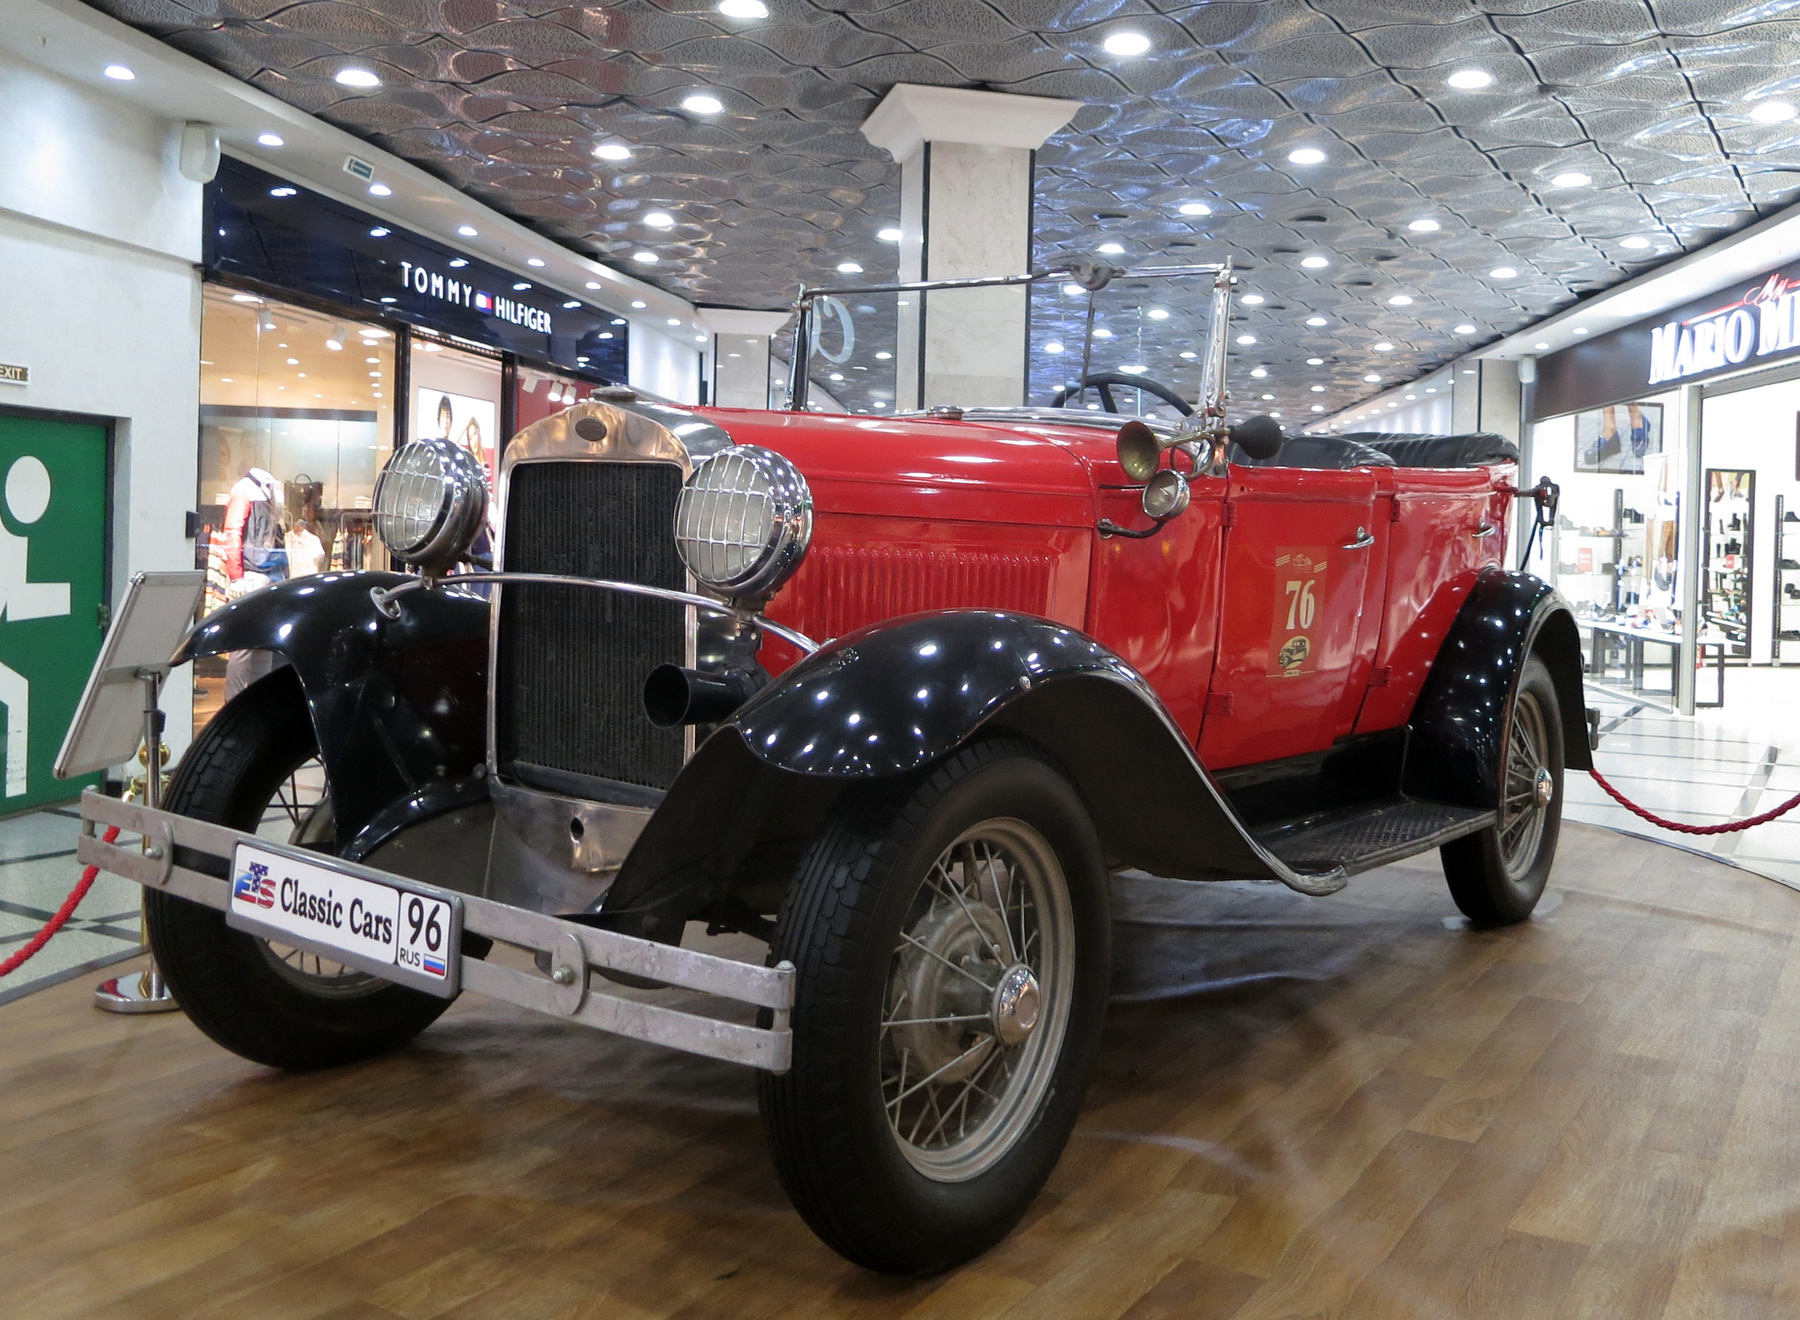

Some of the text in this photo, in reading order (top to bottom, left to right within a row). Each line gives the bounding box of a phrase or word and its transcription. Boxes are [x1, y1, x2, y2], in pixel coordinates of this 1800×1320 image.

[401, 261, 552, 335] TOMMY HILFIGER
[1648, 310, 1755, 384] MARIO
[1285, 579, 1316, 630] 76
[281, 877, 343, 929] Classic
[350, 899, 393, 945] Cars
[408, 898, 442, 952] 96
[400, 947, 421, 967] RUS
